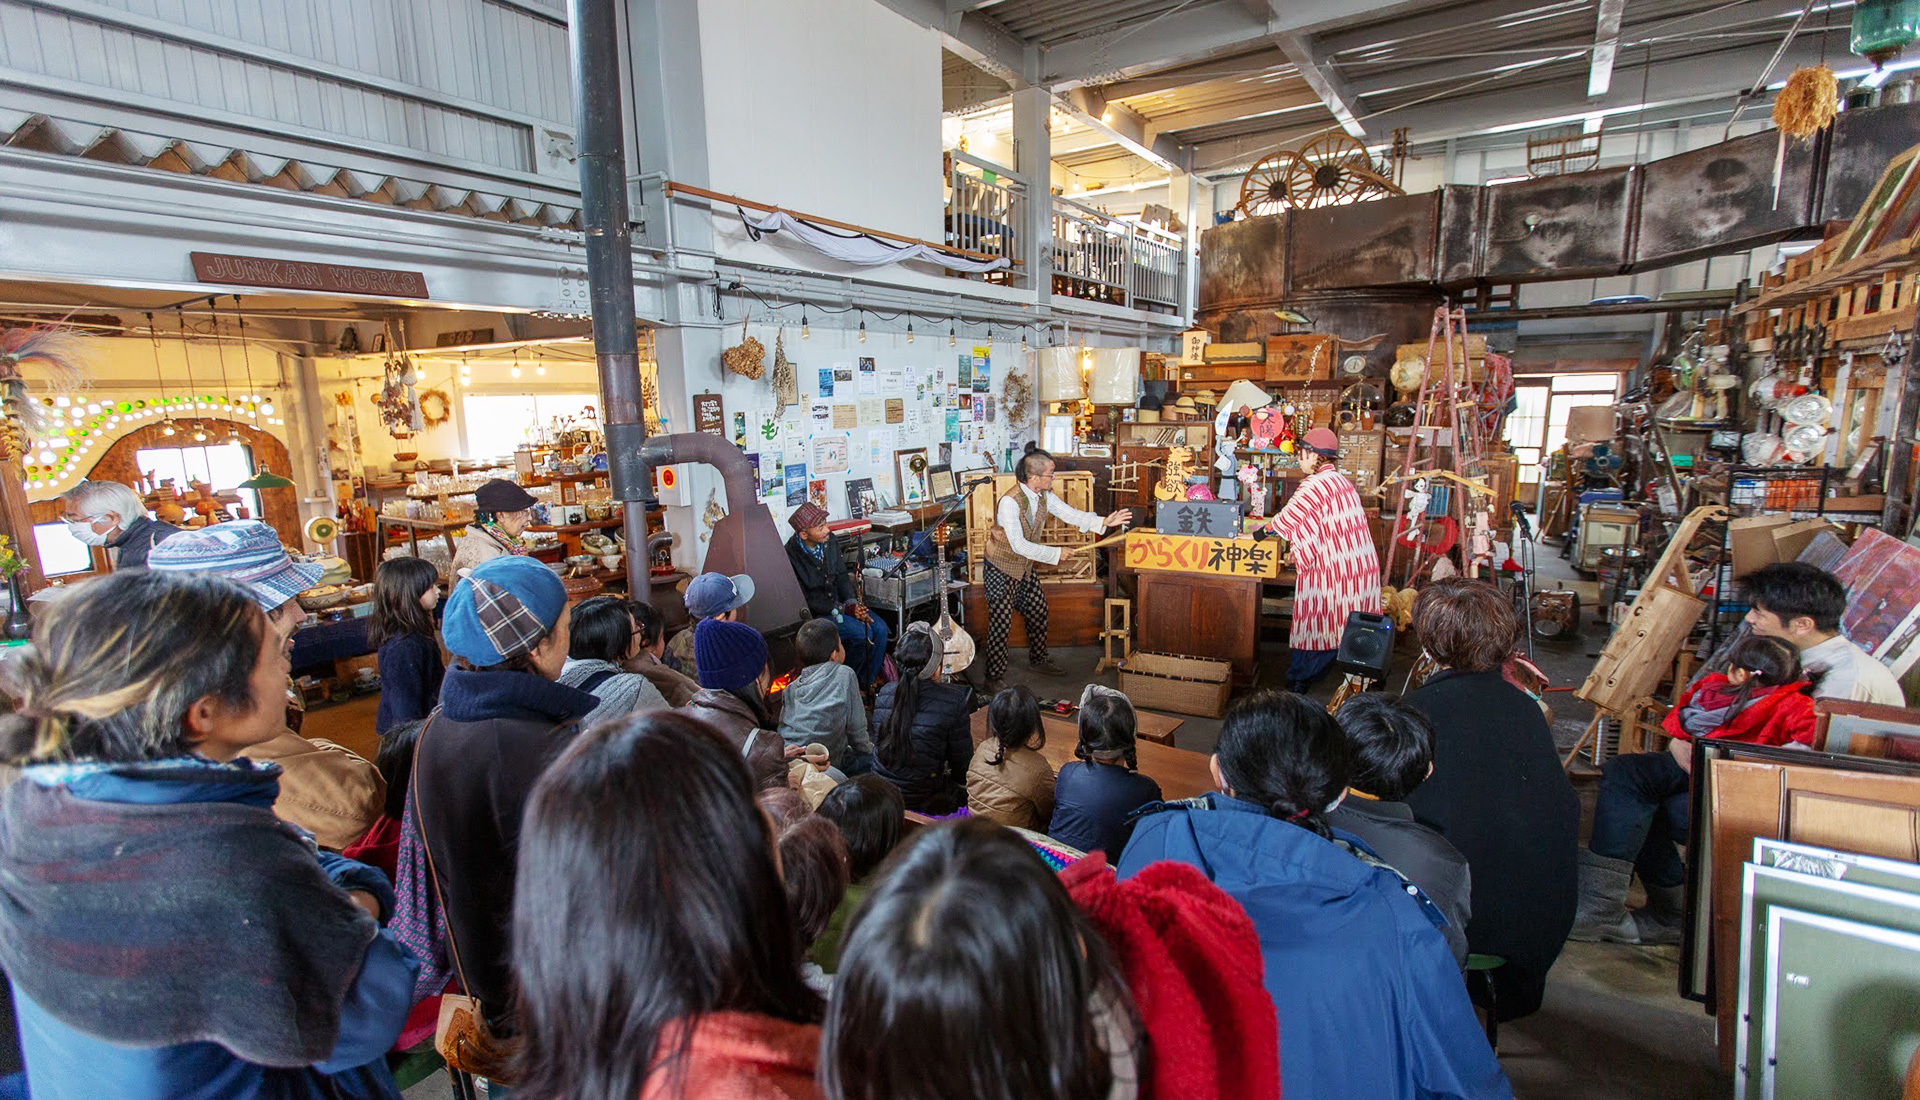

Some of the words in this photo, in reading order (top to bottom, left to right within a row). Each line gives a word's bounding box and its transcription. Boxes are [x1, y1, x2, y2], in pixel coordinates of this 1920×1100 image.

[206, 257, 324, 287] JUNKAN
[329, 267, 418, 295] WORKS
[1177, 505, 1213, 535] 鉄
[1128, 536, 1273, 576] からくり神楽
